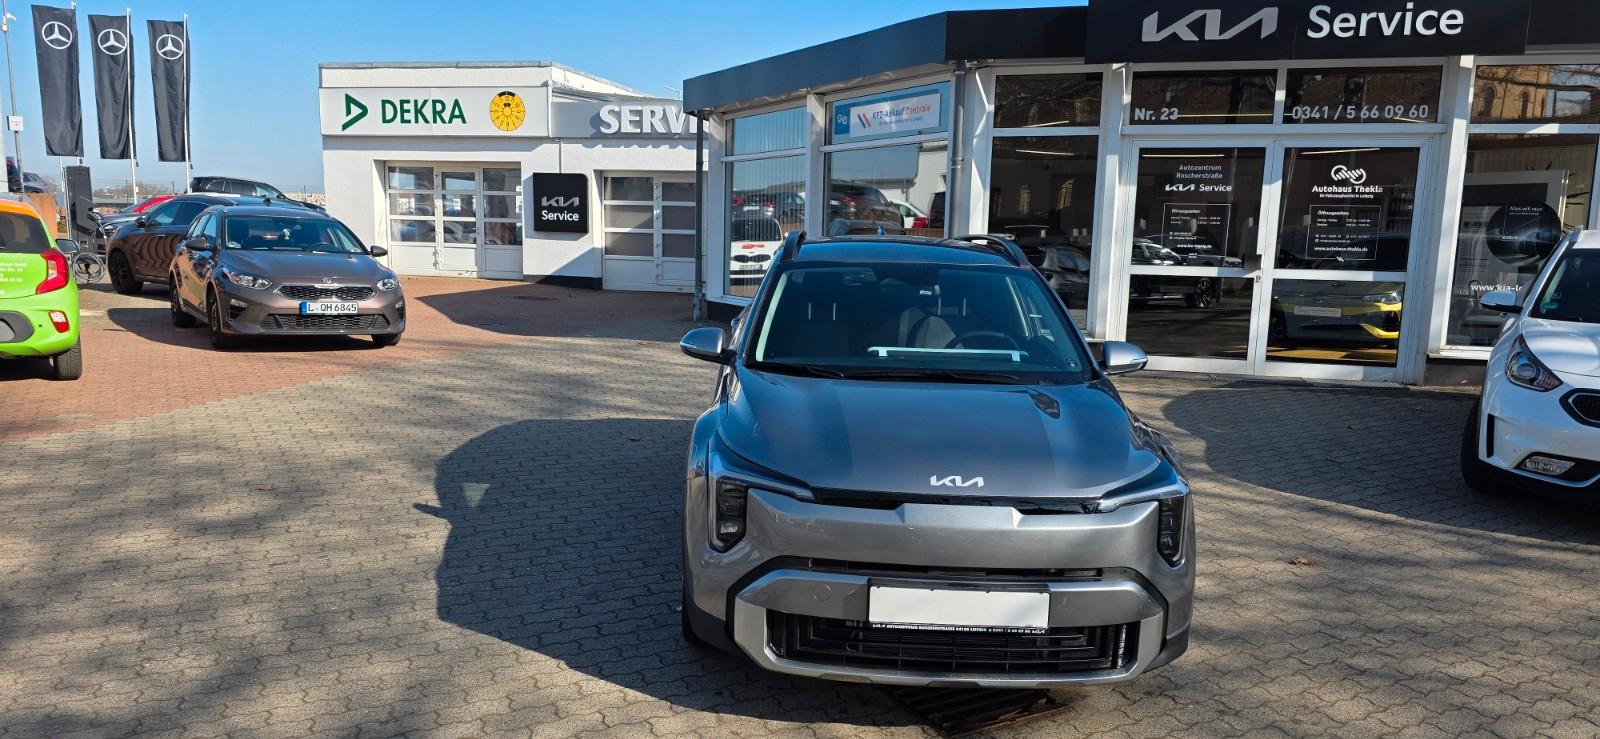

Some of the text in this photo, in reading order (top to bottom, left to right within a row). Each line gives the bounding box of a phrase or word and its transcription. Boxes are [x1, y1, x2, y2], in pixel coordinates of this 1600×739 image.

[1142, 2, 1464, 42] KIA Service
[381, 98, 467, 124] DEKRA
[1134, 108, 1179, 121] Nr. 23
[1292, 105, 1429, 120] 0341 / 5 66 09 60
[1165, 183, 1233, 192] KIA Service
[1311, 184, 1384, 193] Autohaus Thekla
[541, 195, 580, 207] KIA
[541, 210, 580, 221] Service
[308, 303, 314, 312] L
[929, 474, 985, 488] KIA
